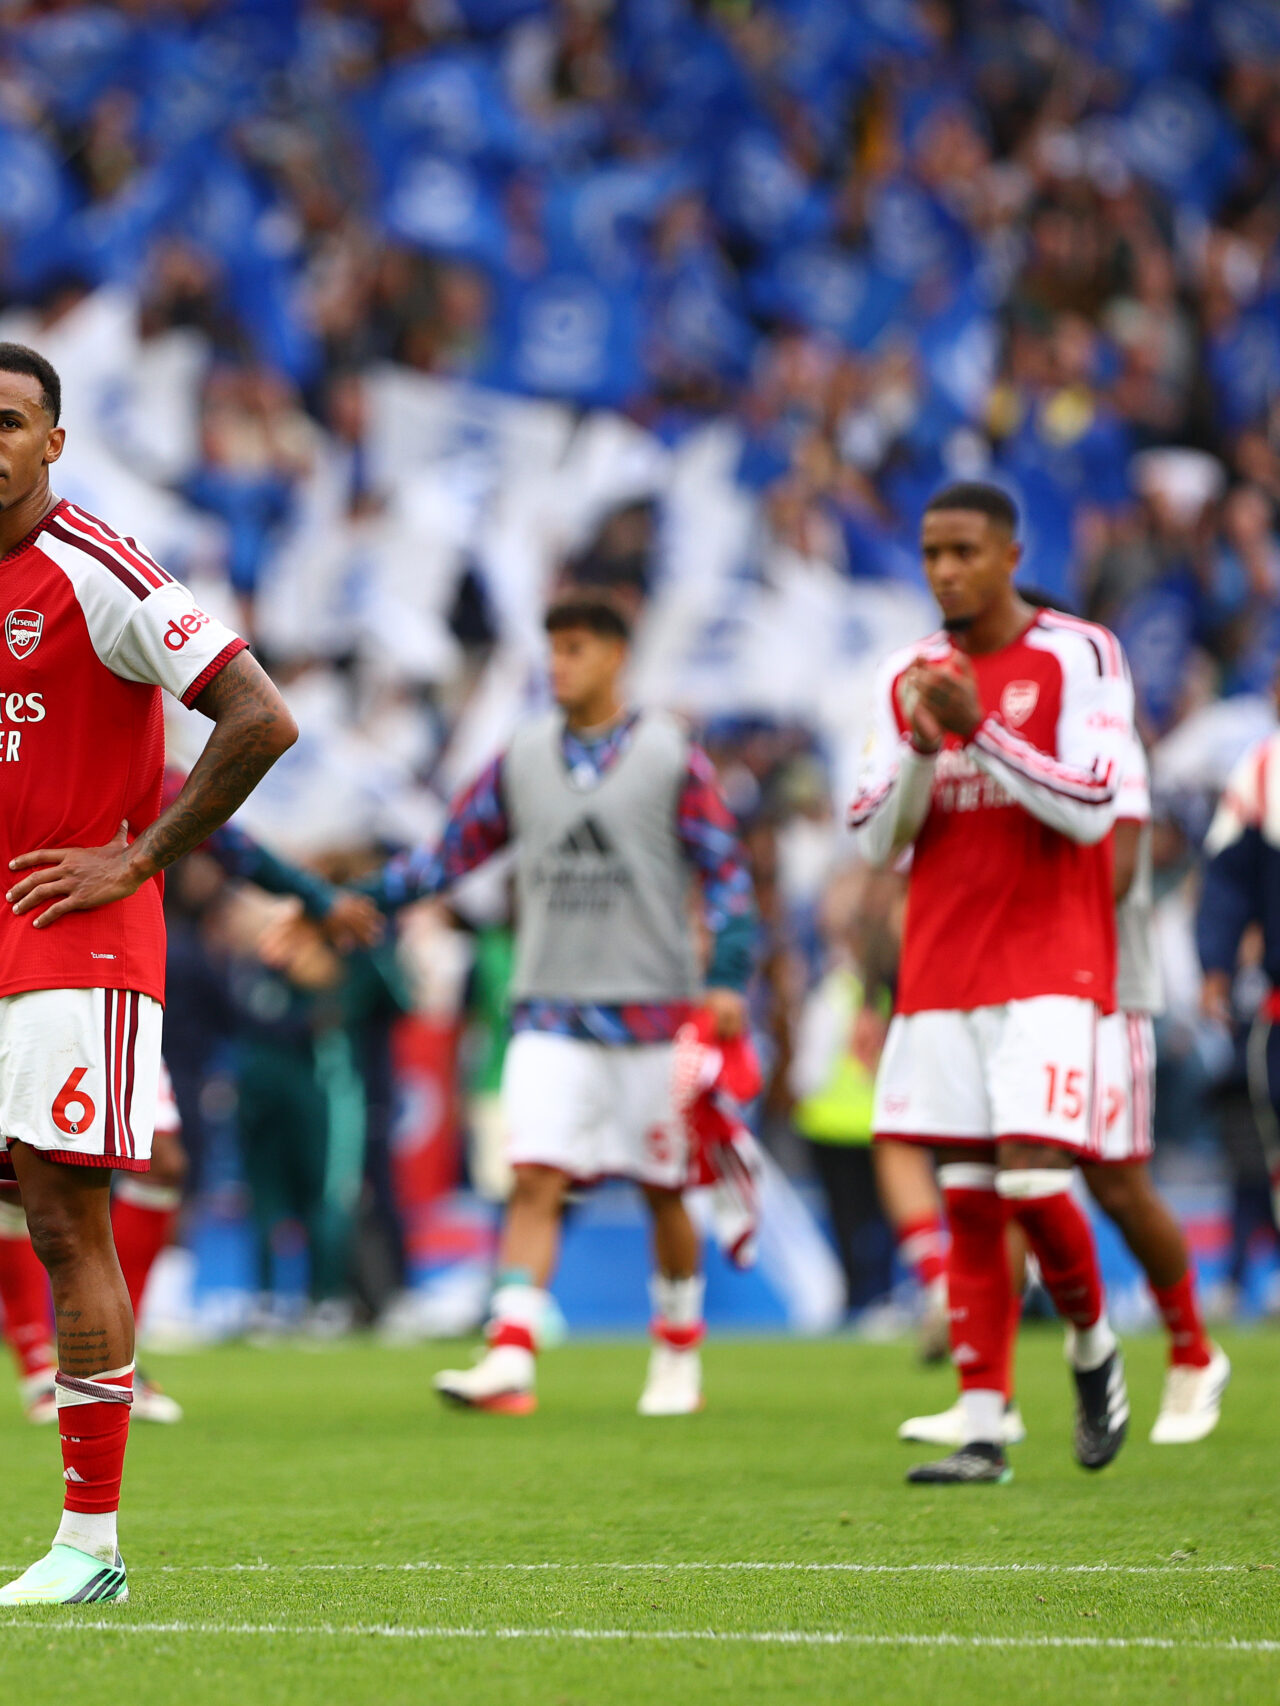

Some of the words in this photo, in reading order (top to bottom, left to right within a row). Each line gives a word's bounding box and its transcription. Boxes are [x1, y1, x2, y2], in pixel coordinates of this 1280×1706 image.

[11, 616, 39, 628] Arsenal
[163, 608, 212, 651] dee
[51, 1067, 96, 1135] 6
[1043, 1063, 1086, 1121] 15
